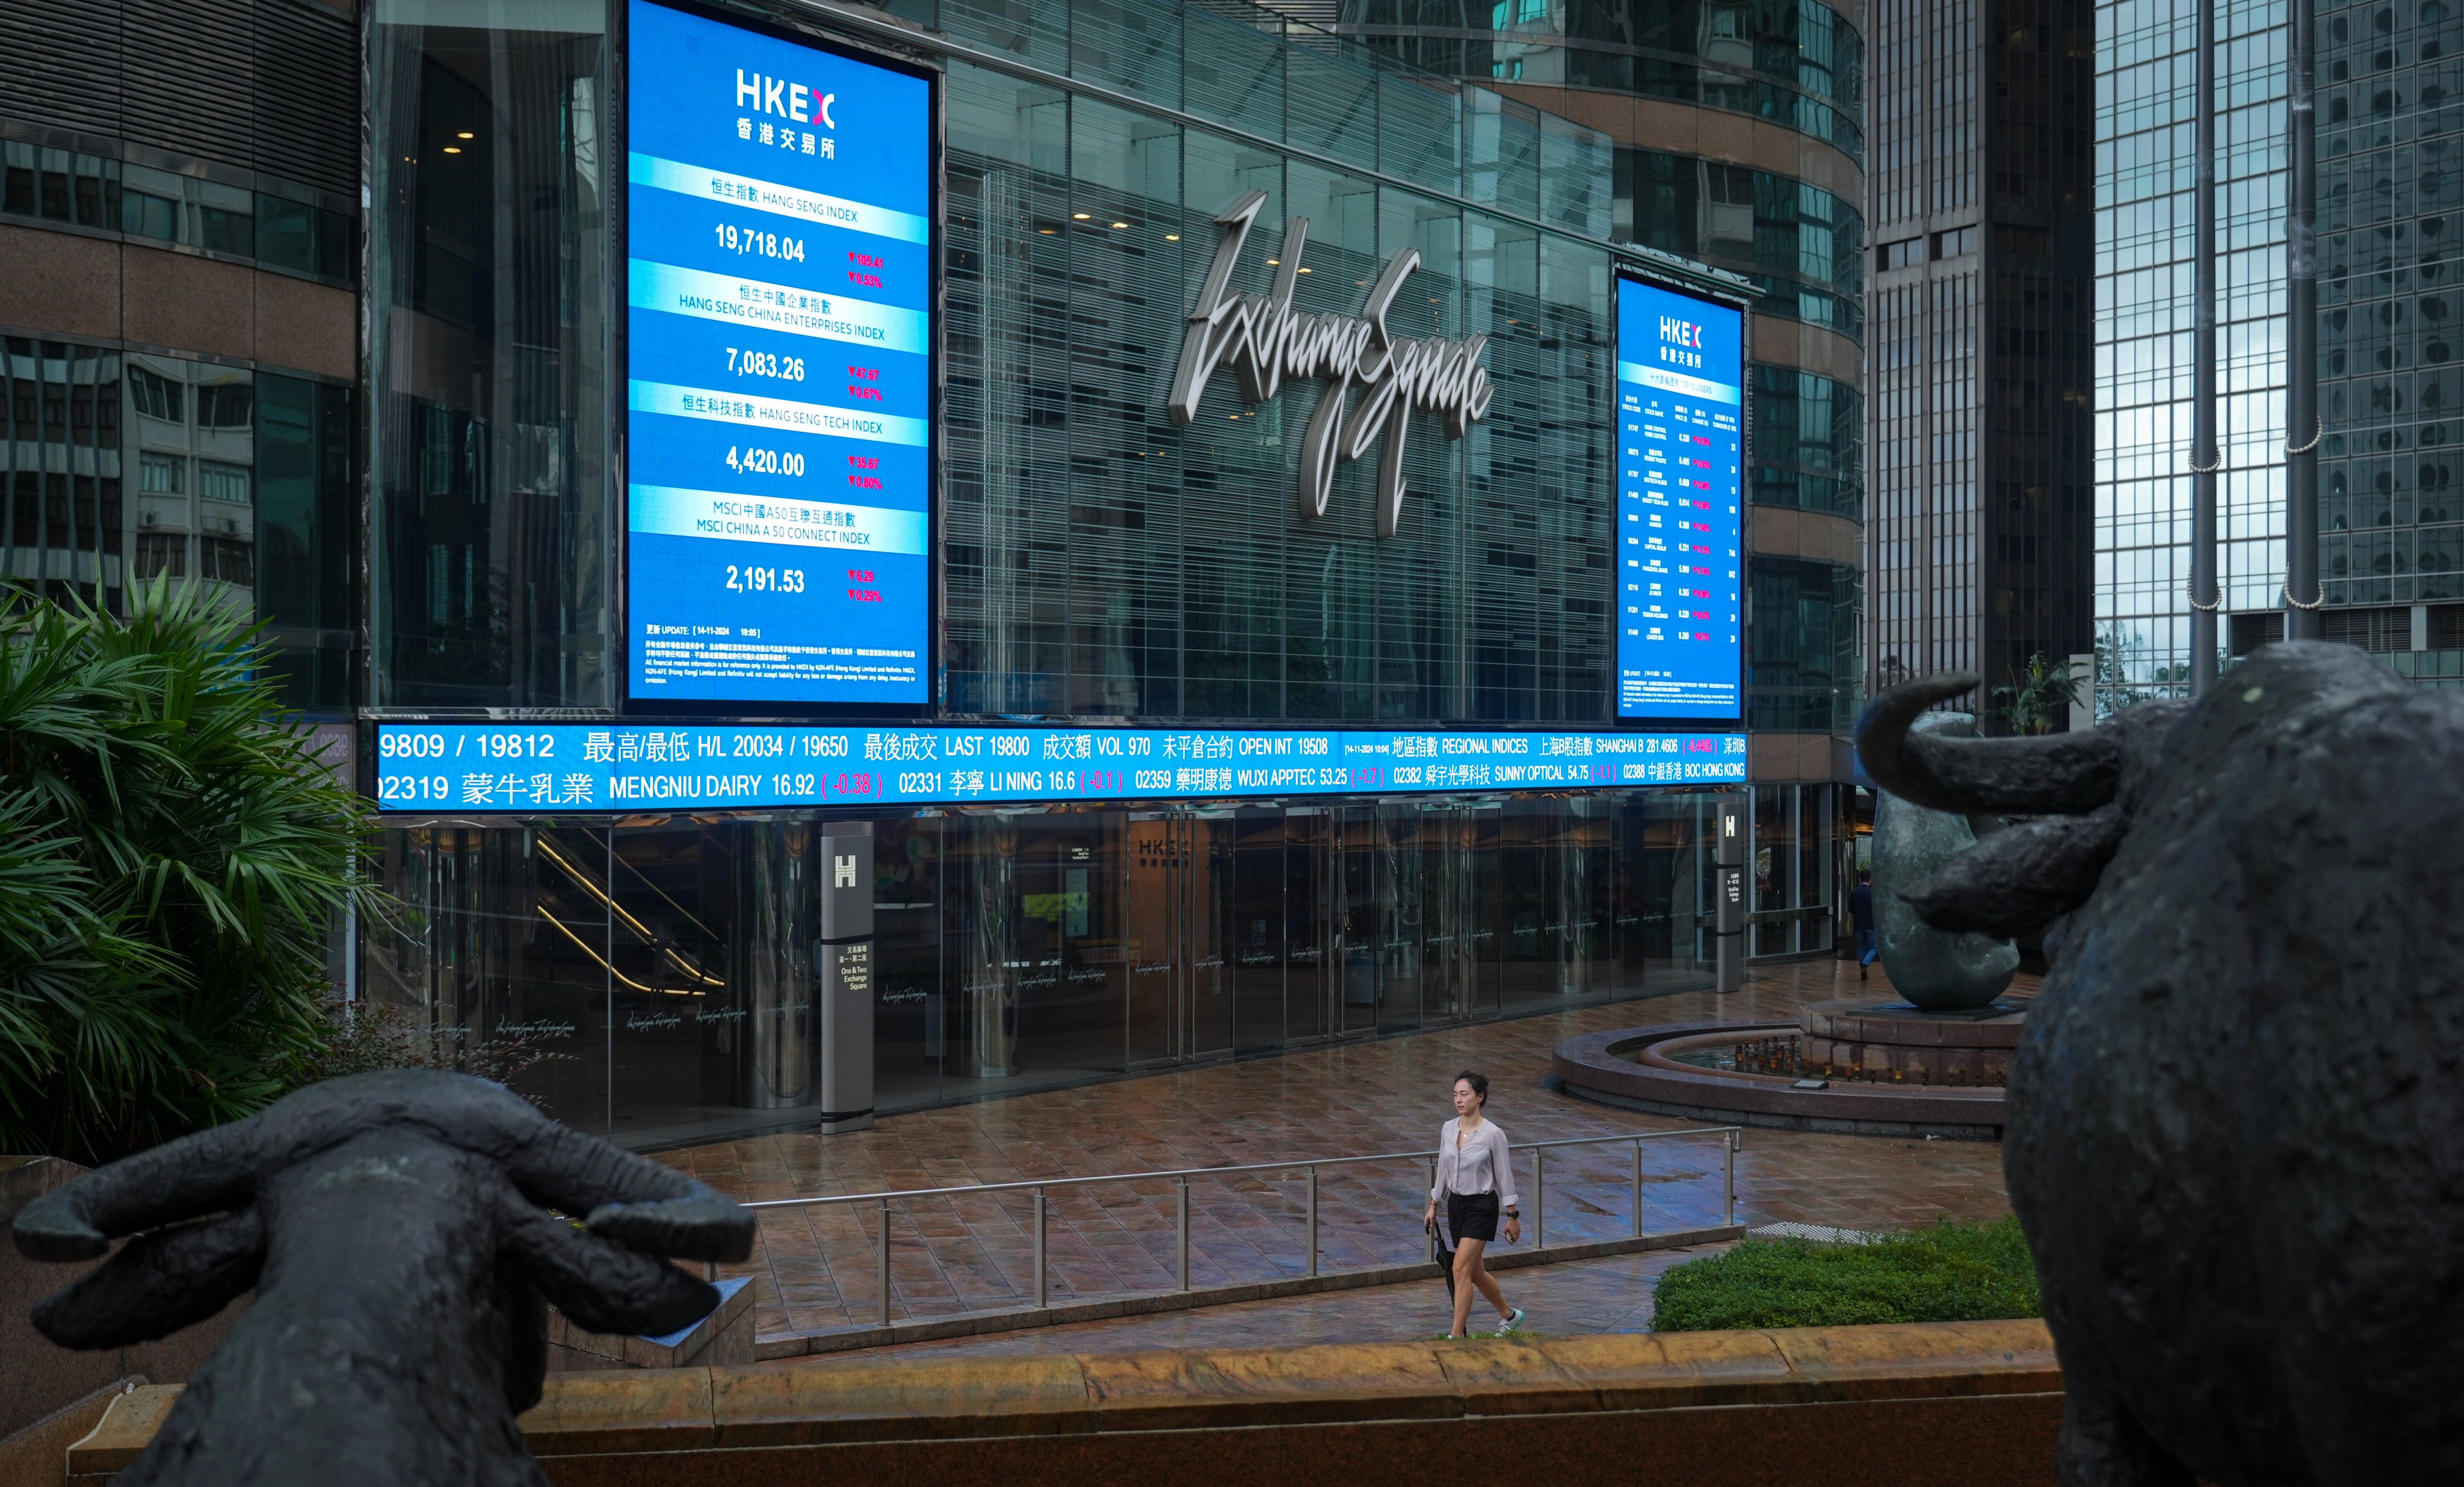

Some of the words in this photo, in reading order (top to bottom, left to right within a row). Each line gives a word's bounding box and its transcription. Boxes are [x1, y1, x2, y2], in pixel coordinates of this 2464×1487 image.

[737, 69, 835, 129] HKEX
[737, 117, 835, 160] 香港交易所
[712, 177, 759, 203] 恒生指數
[763, 192, 794, 209] HANG
[796, 200, 824, 215] SENG
[827, 206, 857, 223] INDEX
[715, 223, 804, 263] 19,718.04
[856, 253, 883, 269] 105.41
[856, 272, 882, 289] 0.53%
[740, 283, 832, 315] 恒生中國企業指數
[679, 294, 714, 311] HANG
[715, 301, 745, 316] SENG
[747, 307, 782, 322] CHINA
[785, 313, 851, 335] ENTERPRISES
[854, 325, 885, 341] INDEX
[1660, 315, 1702, 349] HKEX
[726, 347, 804, 382] 7,083.26
[1661, 346, 1702, 369] 香港交易所
[855, 367, 879, 381] 47.67
[855, 387, 882, 402] 0.67%
[1696, 383, 1712, 394] LOSERS
[682, 394, 755, 419] 恒生科技指數
[759, 407, 791, 422] HANG
[793, 412, 821, 426] SENG
[823, 416, 850, 430] TECH
[851, 420, 883, 434] INDEX
[726, 446, 804, 477] 4,420.00
[856, 457, 879, 470] 35.67
[713, 500, 855, 528] MSCI中國A50互聯互通指數
[697, 519, 723, 532] MSCI
[726, 522, 761, 535] CHINA
[763, 525, 770, 537] A
[773, 526, 785, 538] 50
[787, 528, 837, 543] CONNECT
[839, 532, 870, 546] INDEX
[726, 565, 804, 594] 2,191.53
[856, 570, 874, 582] 6.29
[856, 590, 882, 602] 0.29%
[646, 624, 661, 635] 更新
[661, 626, 690, 635] UPDATE:
[477, 734, 555, 758] 19812
[583, 731, 690, 763] 最高/最低
[698, 736, 726, 757] H/L
[733, 735, 783, 757] 20034
[802, 735, 848, 757] 19650
[864, 733, 938, 761] 最後成交
[945, 736, 984, 756] LAST
[990, 736, 1030, 756] 19800
[1043, 733, 1091, 760] 成交額
[1096, 736, 1123, 756] VOL
[1129, 736, 1150, 756] 970
[1163, 734, 1233, 760] 未平倉合約
[1239, 737, 1272, 756] OPEN
[1274, 737, 1293, 755] INT
[1298, 737, 1328, 756] 19508
[1392, 736, 1438, 758] 地區指數
[1442, 737, 1490, 754] REGIONAL
[1492, 738, 1528, 754] INDICES
[1539, 736, 1593, 757] 上海B股指數
[1596, 739, 1636, 753] SHANGHAI
[1638, 739, 1643, 753] B
[1646, 738, 1678, 753] 281.4606
[462, 772, 594, 805] 蒙牛乳業
[610, 775, 701, 799] MENGNIU
[706, 774, 762, 797] DAIRY
[772, 774, 815, 795] 16.92
[899, 772, 942, 793] 02331
[949, 768, 984, 796] 李寧
[990, 772, 1002, 791] LI
[1006, 771, 1042, 791] NING
[1049, 771, 1075, 790] 16.6
[1135, 770, 1172, 789] 02359
[1176, 767, 1232, 792] 藥明康德
[1238, 768, 1268, 787] WUXI
[1270, 768, 1316, 786] APPTEC
[1320, 768, 1347, 786] 53.25
[1394, 766, 1422, 784] 02382
[1425, 764, 1491, 786] 舜宇光學科技
[1495, 765, 1526, 781] SUNNY
[1527, 765, 1564, 781] OPTICAL
[1567, 765, 1588, 780] 54.75
[1623, 763, 1645, 779] 02388
[1648, 762, 1682, 781] 中銀香港
[1685, 763, 1701, 777] BOC
[1702, 763, 1723, 777] HONG
[1724, 762, 1745, 776] KONG
[847, 944, 867, 954] 交易廣場
[850, 982, 867, 991] Square
